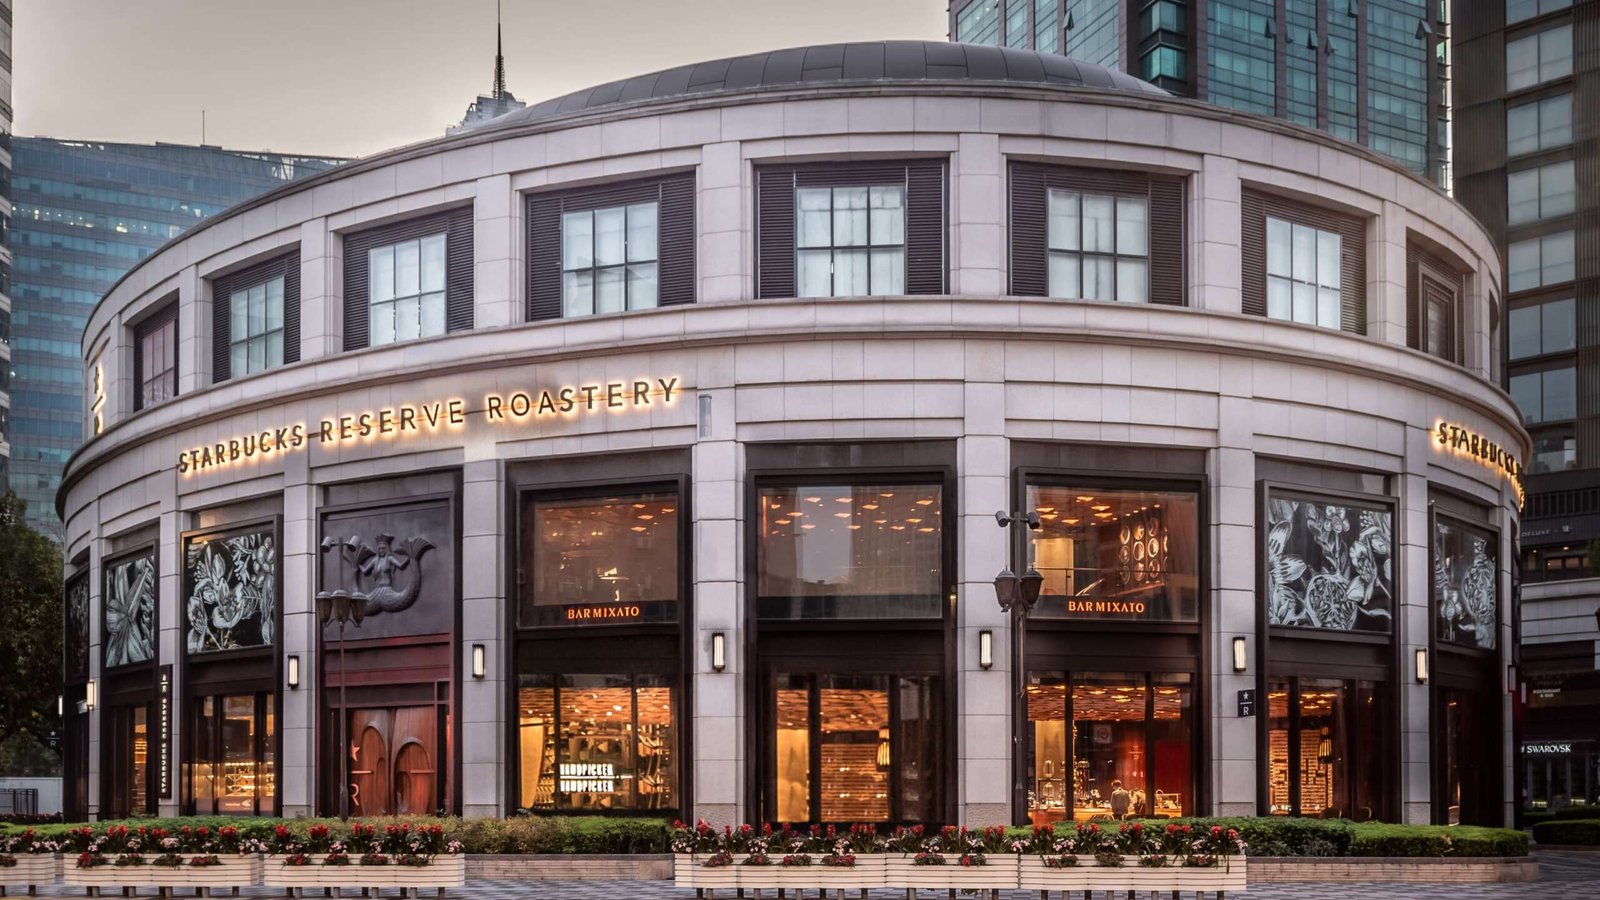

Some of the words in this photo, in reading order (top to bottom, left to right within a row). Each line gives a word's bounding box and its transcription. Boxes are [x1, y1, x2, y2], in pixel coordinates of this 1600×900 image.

[179, 425, 303, 473] STARBUCKS
[320, 401, 464, 442] RESERVE
[488, 378, 677, 420] ROASTERY
[1243, 706, 1249, 715] R
